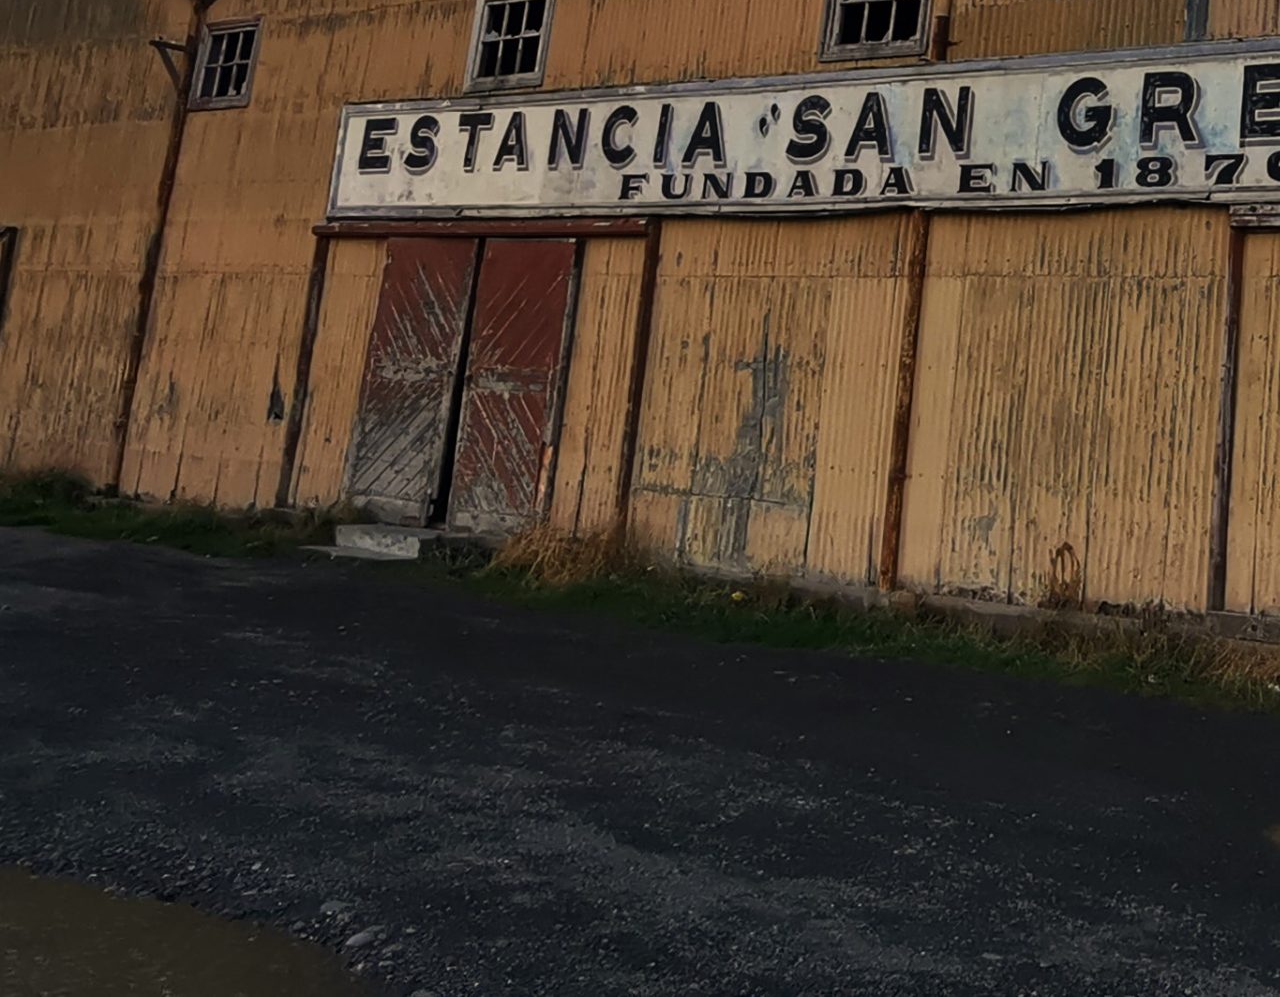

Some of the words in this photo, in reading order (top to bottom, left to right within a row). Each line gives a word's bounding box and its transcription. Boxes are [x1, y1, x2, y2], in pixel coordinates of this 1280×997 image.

[358, 101, 728, 175] ESTANCIA
[618, 165, 913, 202] FUNDADA
[957, 160, 1052, 194] EN
